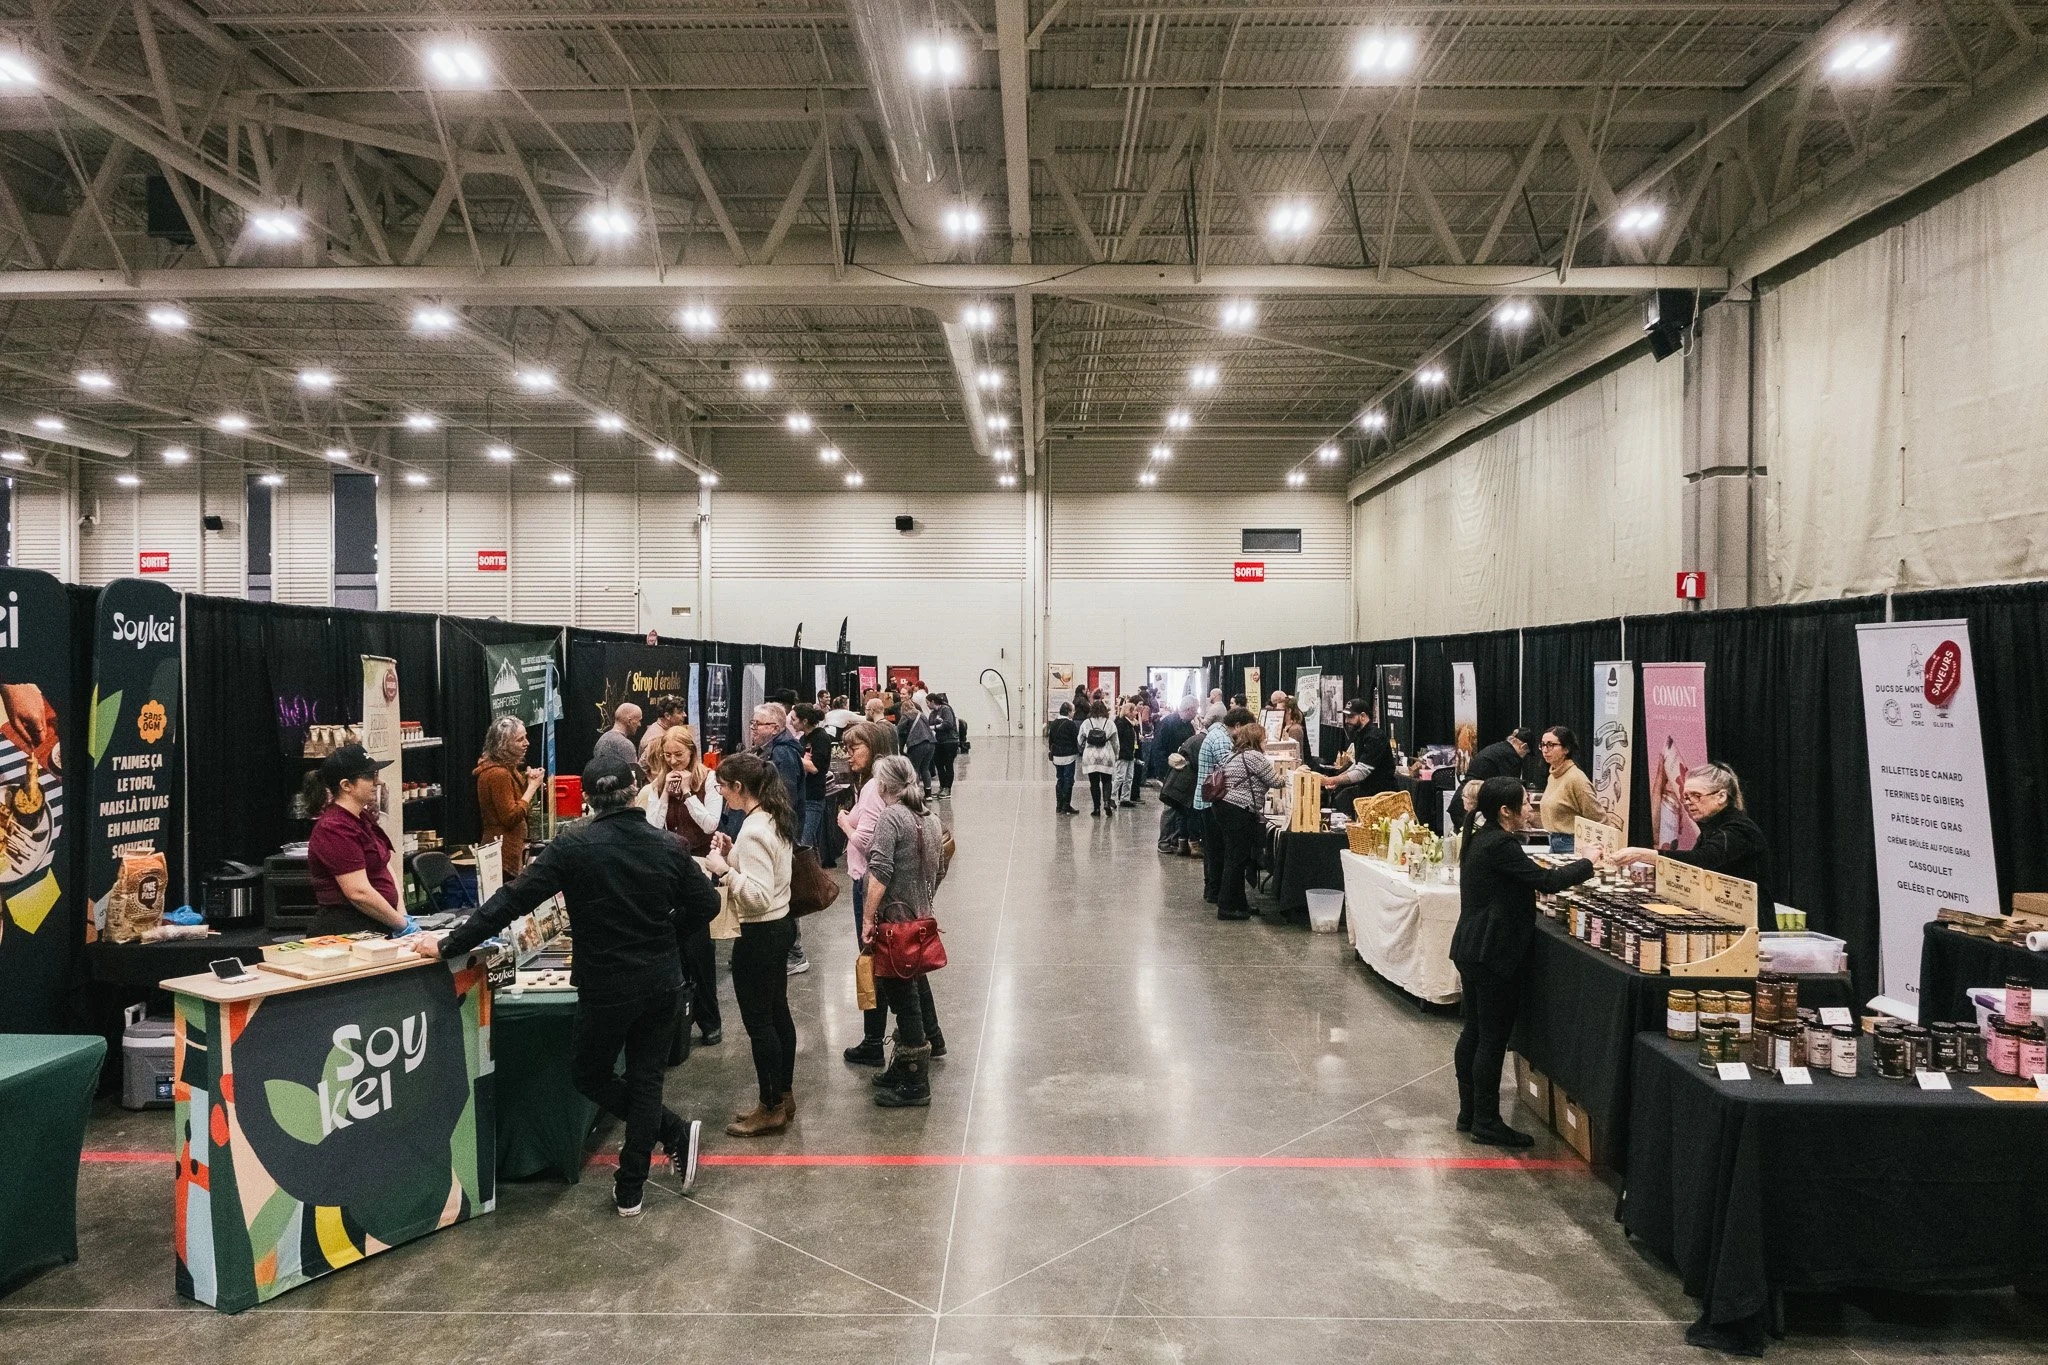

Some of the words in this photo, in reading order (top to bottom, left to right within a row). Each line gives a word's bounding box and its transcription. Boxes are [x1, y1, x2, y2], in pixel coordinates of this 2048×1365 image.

[141, 556, 168, 568] SORTIE
[479, 555, 507, 566] SORTIE
[1235, 567, 1264, 577] SORTIE
[112, 612, 175, 649] Soykei
[1931, 650, 1954, 696] SAVEURS
[632, 671, 653, 698] Sirop
[1875, 685, 1895, 693] DUCS
[1895, 685, 1904, 693] DE
[1904, 685, 1924, 693] MONT
[1653, 685, 1697, 707] COMONT
[143, 721, 160, 731] OGM
[112, 754, 149, 771] T'AIMES
[150, 753, 162, 771] ÇA
[1881, 765, 1918, 777] RILLETTES
[1920, 769, 1930, 778] DE
[1931, 771, 1963, 781] CANARD
[117, 778, 129, 792] LE
[129, 775, 156, 791] TOFU,
[99, 800, 125, 817] MAIS
[125, 795, 138, 815] LÀ
[138, 797, 151, 811] TU
[151, 795, 169, 809] VAS
[1885, 789, 1919, 801] TERRINES
[1921, 794, 1931, 803] DE
[1933, 795, 1964, 807] GIBIERS
[107, 823, 121, 838] EN
[121, 817, 160, 836] MANGER
[1891, 812, 1910, 824] PÂTÉ
[1911, 816, 1919, 826] DE
[1920, 818, 1938, 829] FOIE
[1940, 821, 1963, 832] GRAS
[1930, 843, 1938, 851] AU
[1939, 844, 1954, 854] FOIE
[1954, 847, 1971, 857] GRAS
[1908, 860, 1953, 876] CASSOULET
[1897, 880, 1925, 894] GELÉES
[1926, 886, 1935, 896] ET
[1936, 889, 1969, 904] CONFITS
[488, 967, 515, 983] Soykei
[332, 1011, 428, 1080] Soy
[317, 1069, 392, 1137] kei
